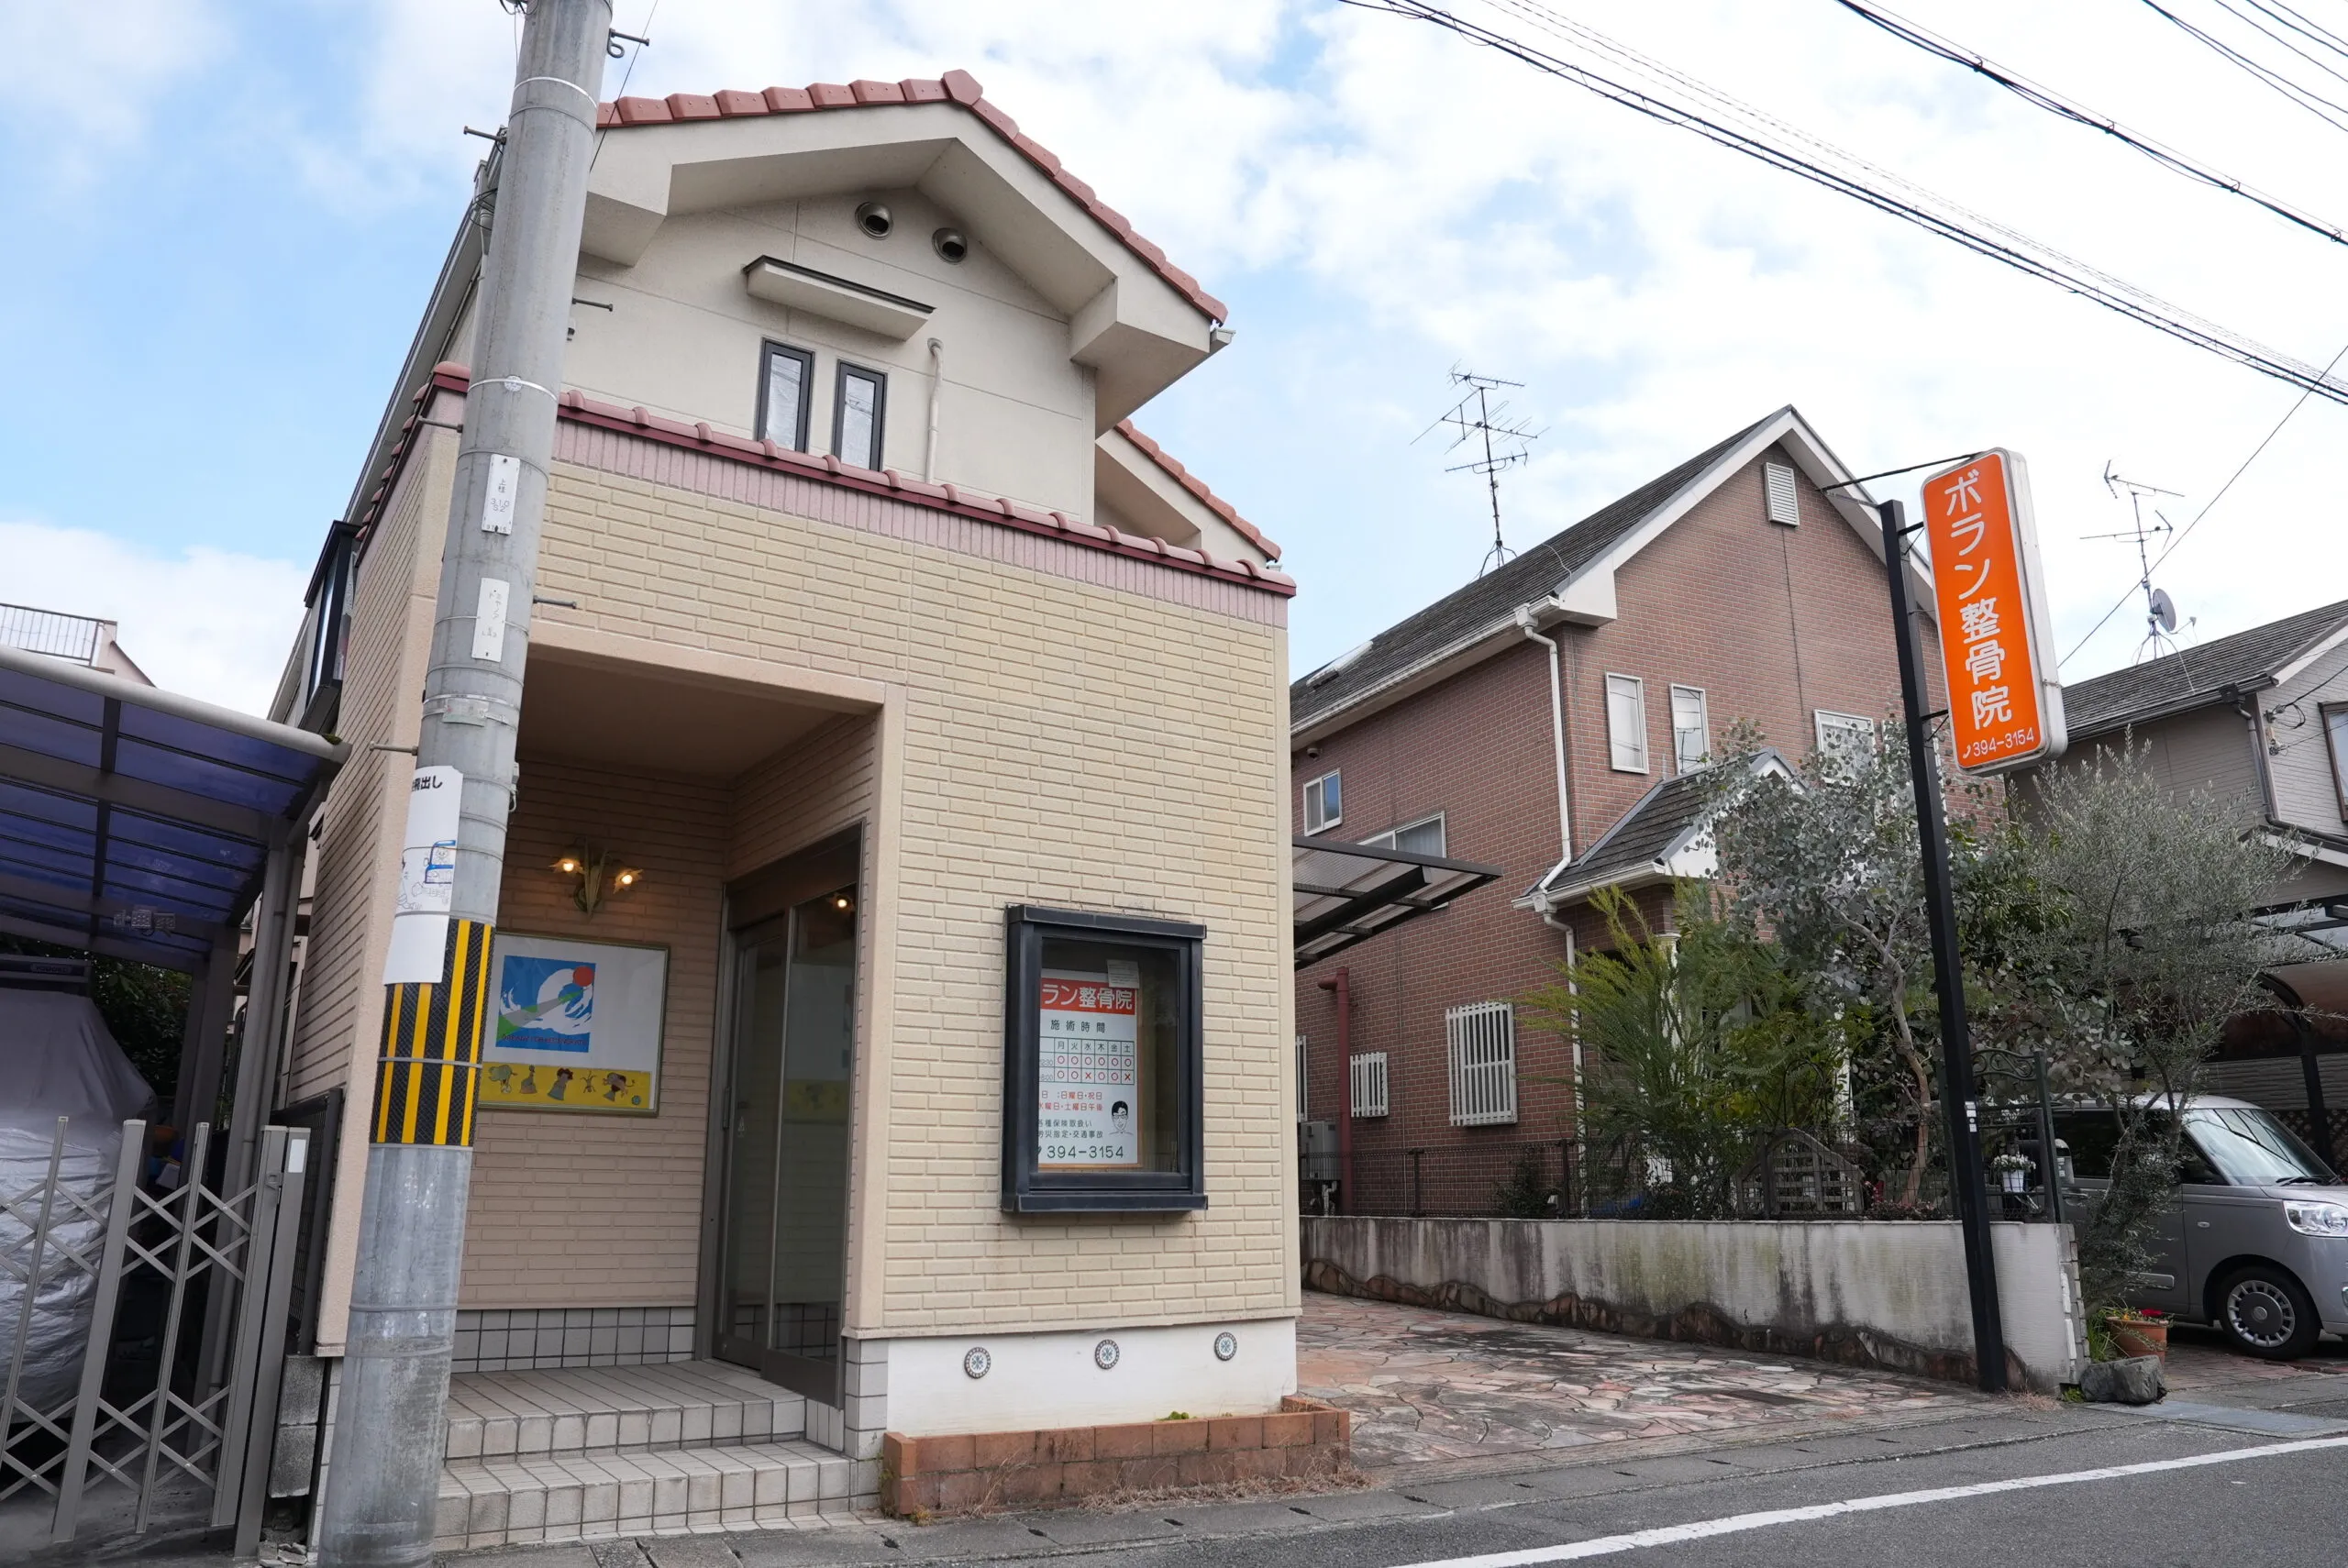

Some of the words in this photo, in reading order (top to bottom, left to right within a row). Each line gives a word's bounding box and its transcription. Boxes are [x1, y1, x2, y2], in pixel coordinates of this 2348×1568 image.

[1944, 469, 2012, 731] ボラン整骨院
[1972, 727, 2035, 758] 394-3154
[1042, 983, 1133, 1010] ラン整骨院
[1050, 1019, 1106, 1033] 施術時間
[1058, 1042, 1065, 1050] 月
[1097, 1043, 1105, 1052] 木
[1124, 1044, 1131, 1053] 土
[1047, 1145, 1124, 1159] 394-3154
